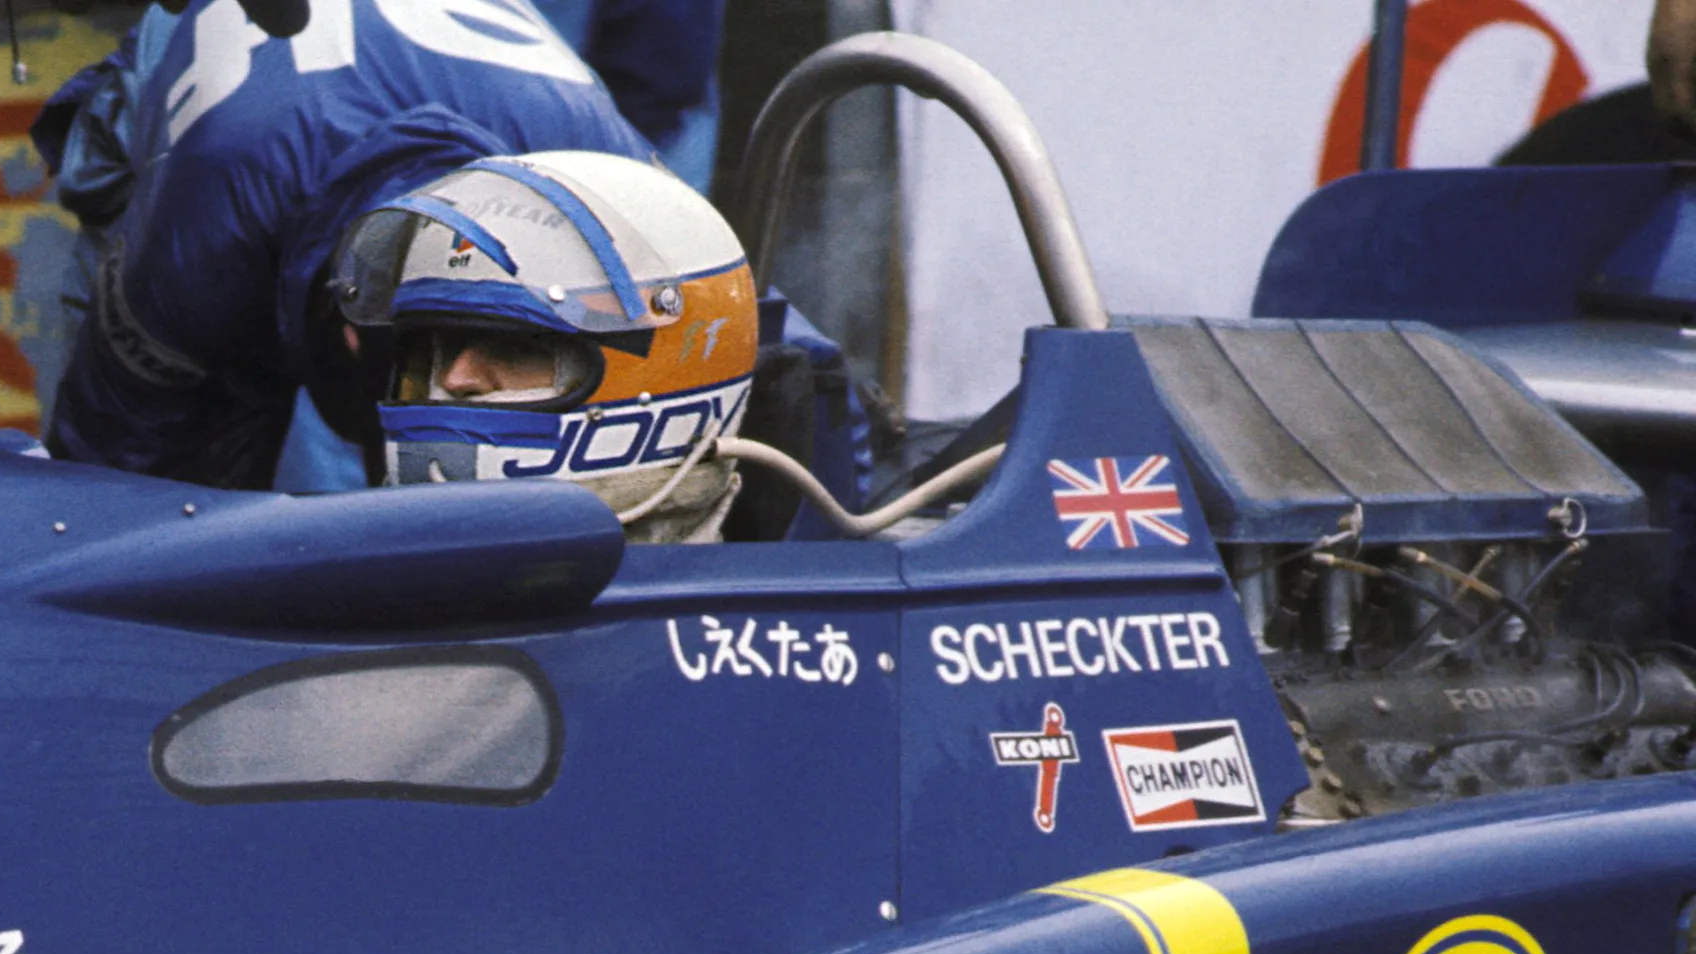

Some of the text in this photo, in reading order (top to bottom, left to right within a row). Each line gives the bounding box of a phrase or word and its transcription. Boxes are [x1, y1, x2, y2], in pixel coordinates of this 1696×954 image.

[448, 254, 472, 268] elf
[667, 614, 857, 686] しえくたあ
[929, 612, 1231, 685] SCHECKTER
[1443, 686, 1543, 712] FORD
[997, 737, 1071, 760] KONI
[1125, 757, 1244, 796] CHAMPION
